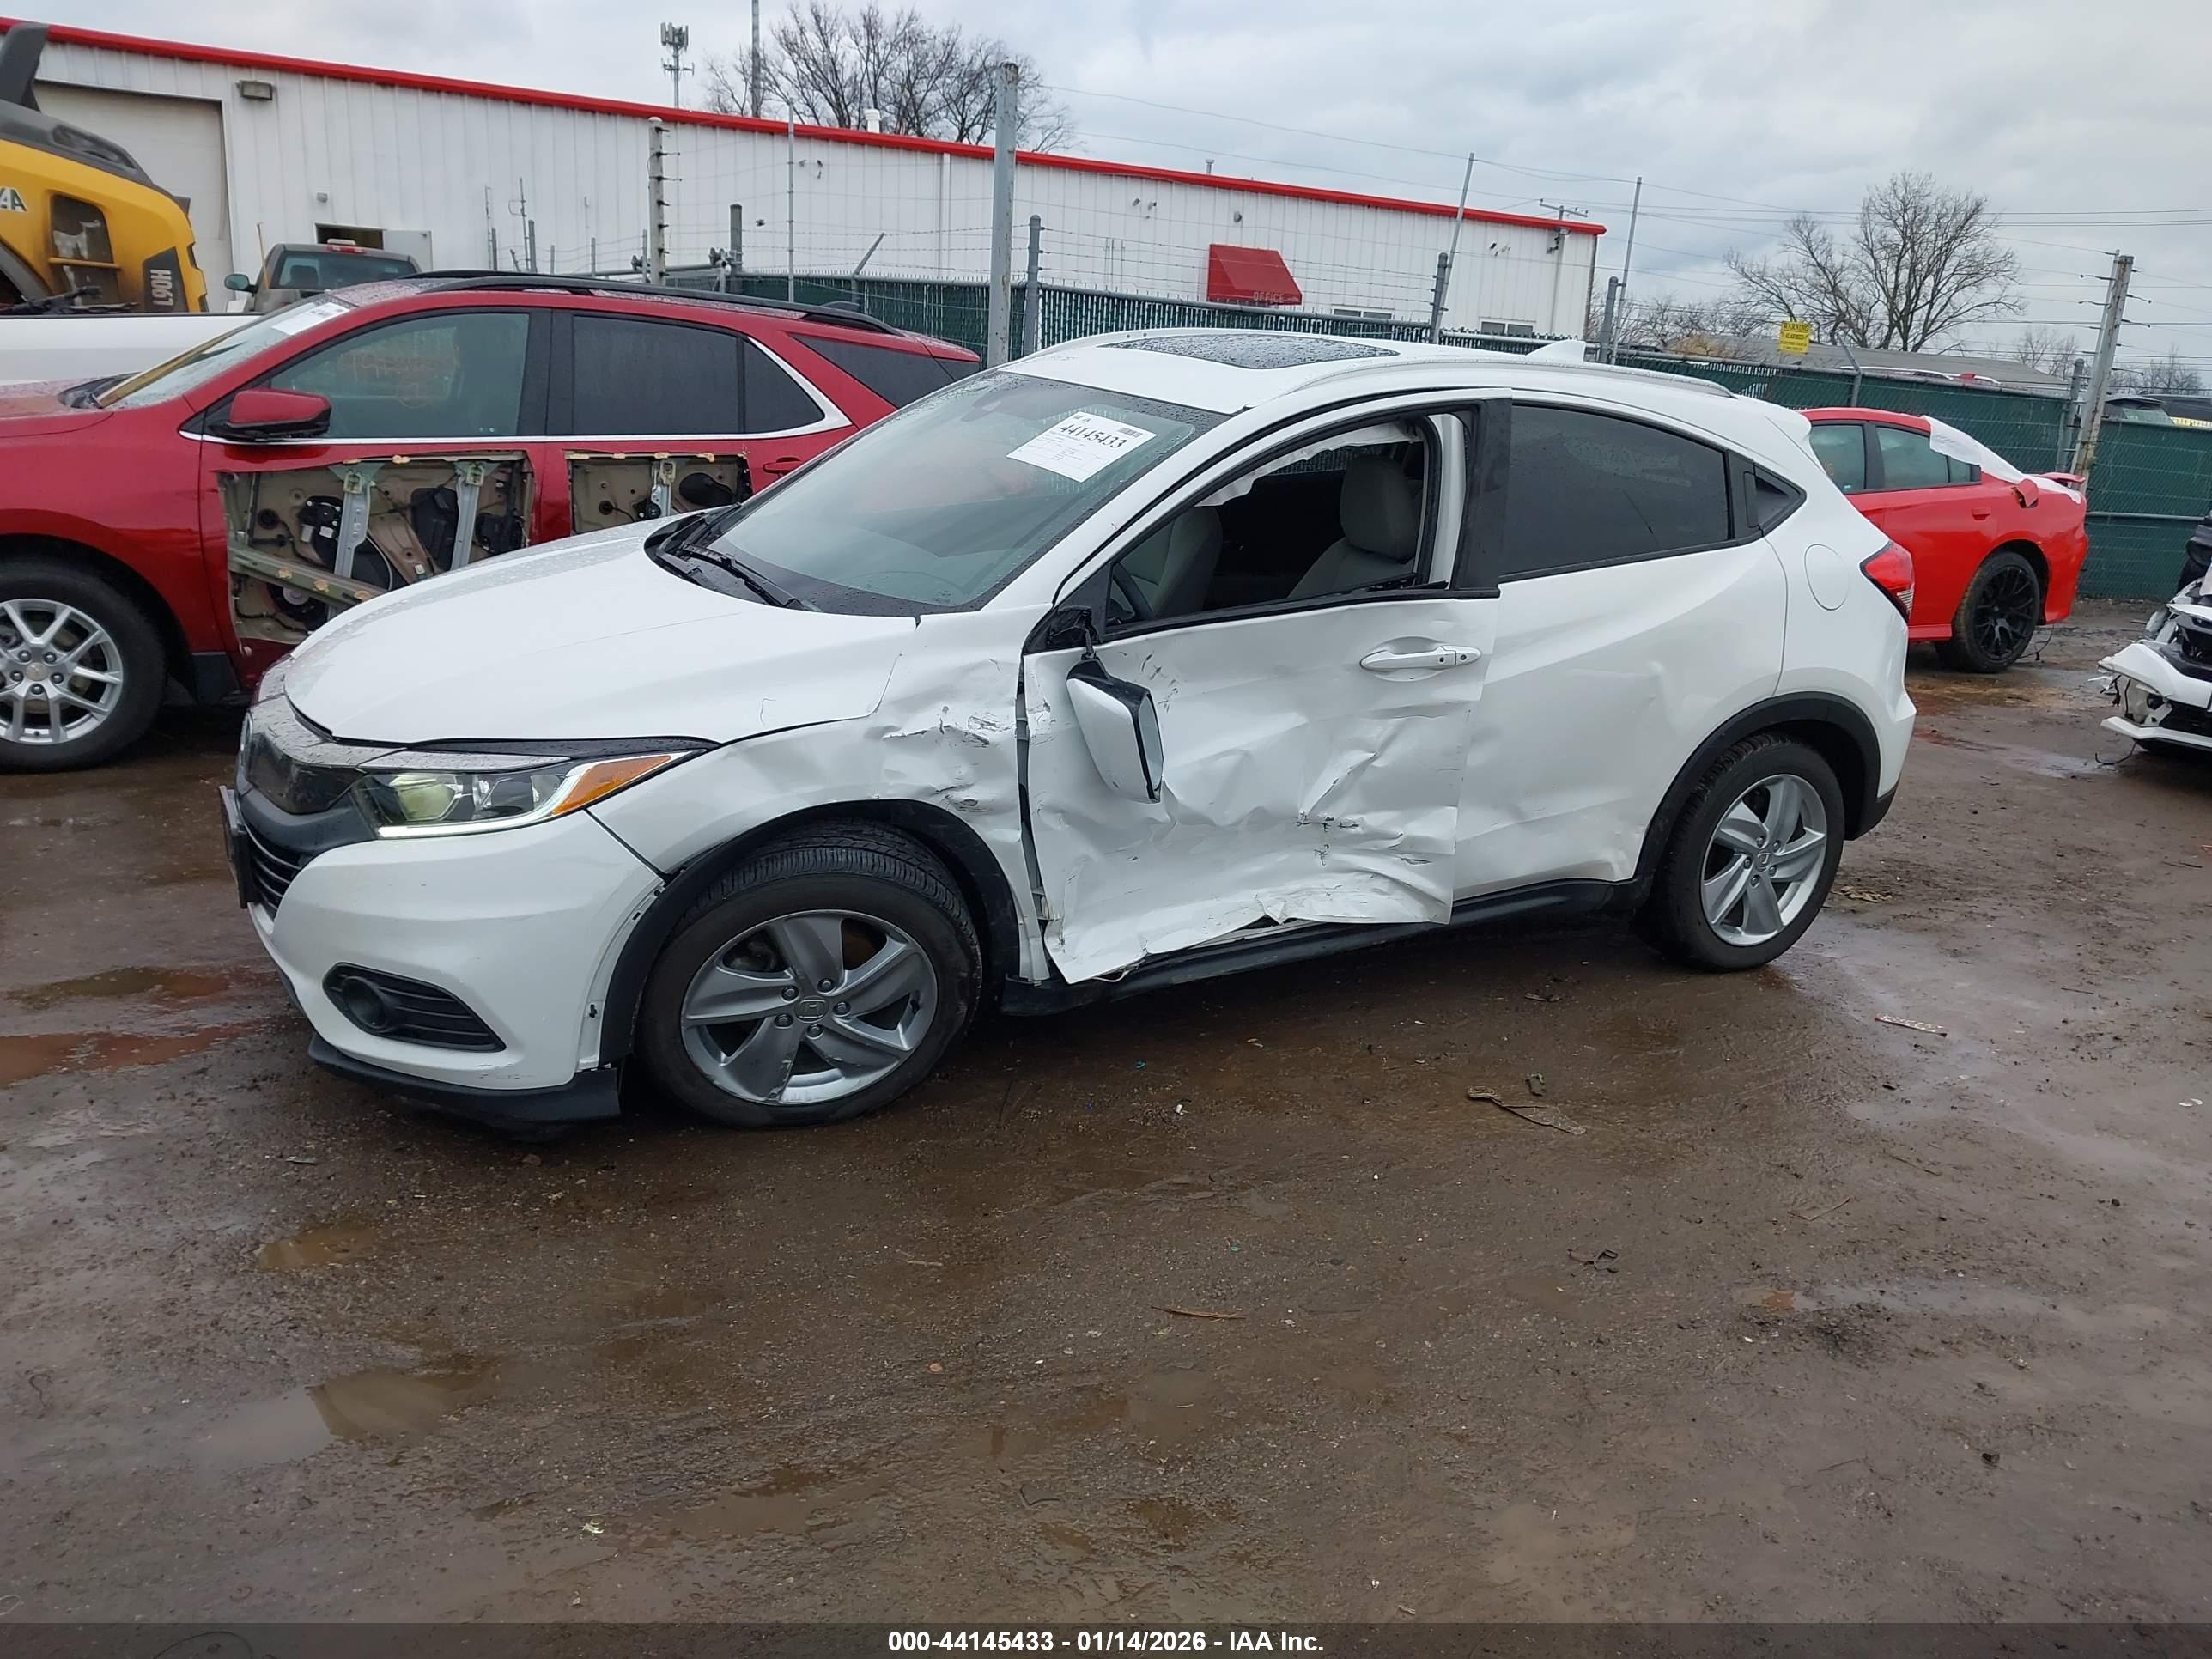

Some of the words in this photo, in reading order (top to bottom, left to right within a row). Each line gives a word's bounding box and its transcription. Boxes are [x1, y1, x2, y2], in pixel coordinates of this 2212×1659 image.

[149, 268, 174, 307] L90H
[1253, 291, 1285, 303] OFFICE
[1060, 424, 1127, 448] 44145433
